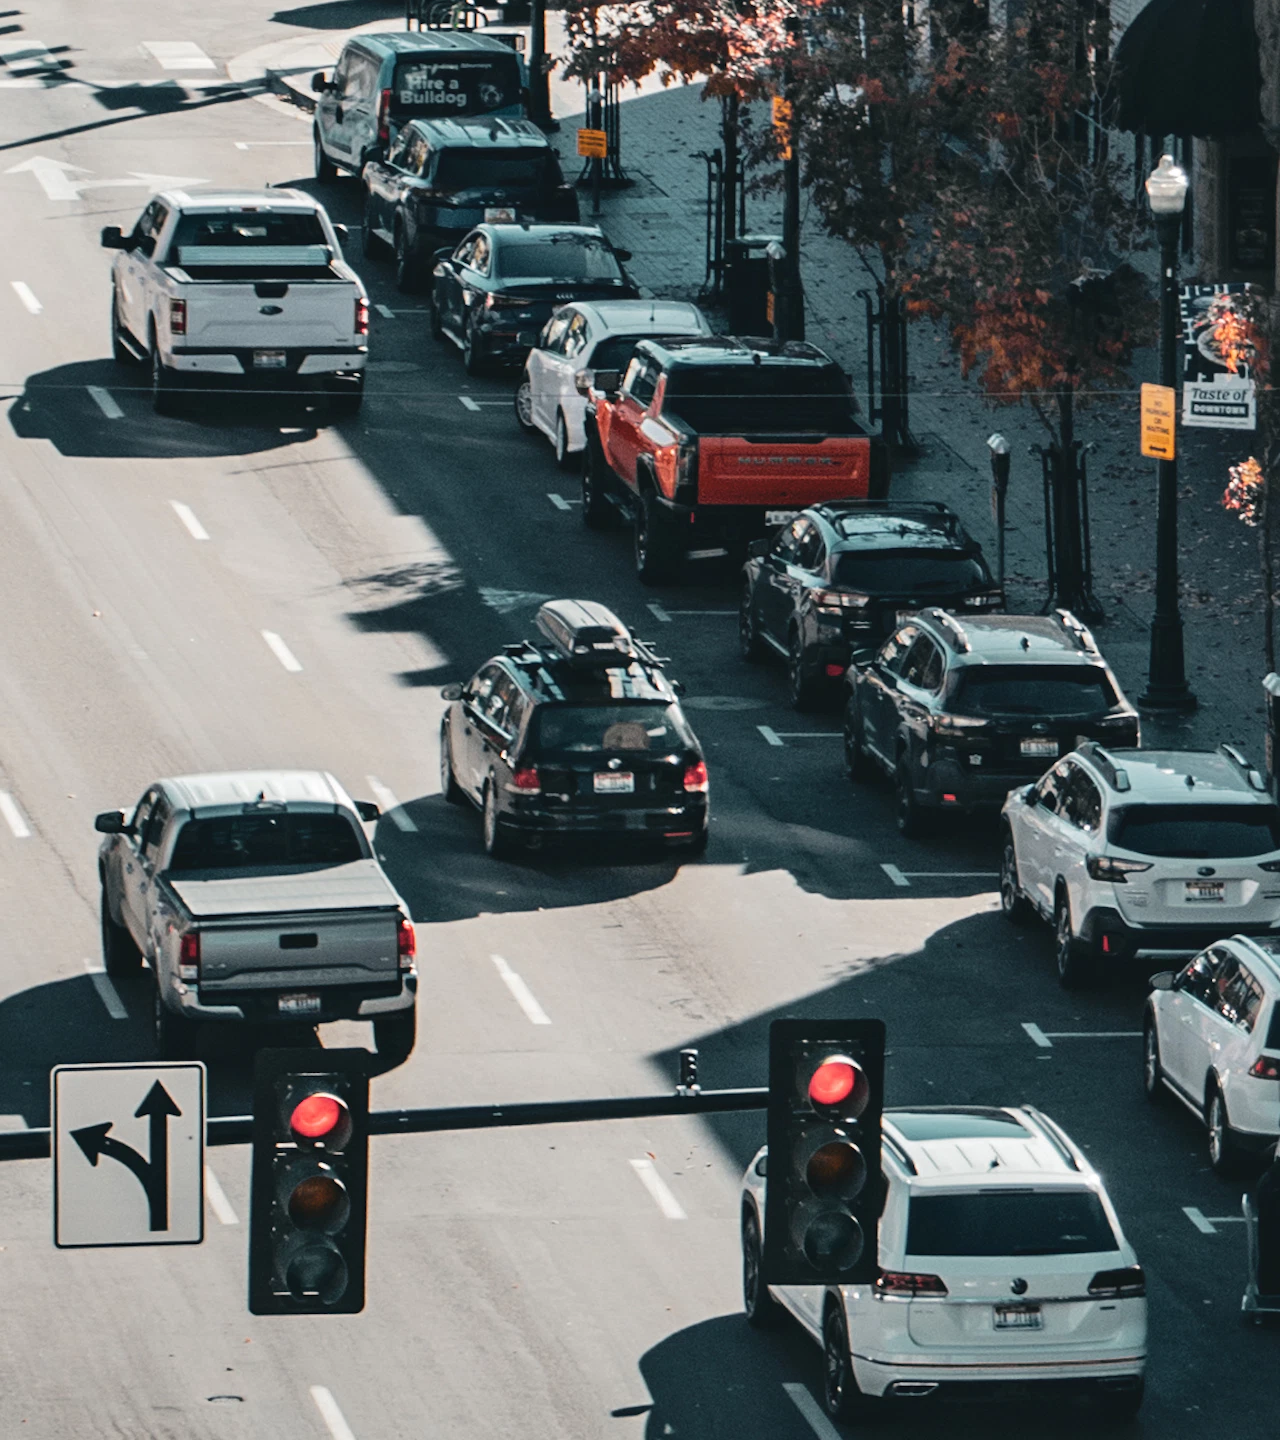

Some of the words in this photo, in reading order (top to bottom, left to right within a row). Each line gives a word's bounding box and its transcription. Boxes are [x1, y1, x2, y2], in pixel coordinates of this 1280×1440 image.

[409, 78, 445, 90] Hire
[449, 79, 459, 90] a
[400, 90, 467, 107] Bulldog
[1192, 388, 1230, 401] Taste
[1233, 389, 1248, 403] of
[1193, 403, 1247, 415] DOWNTOWN
